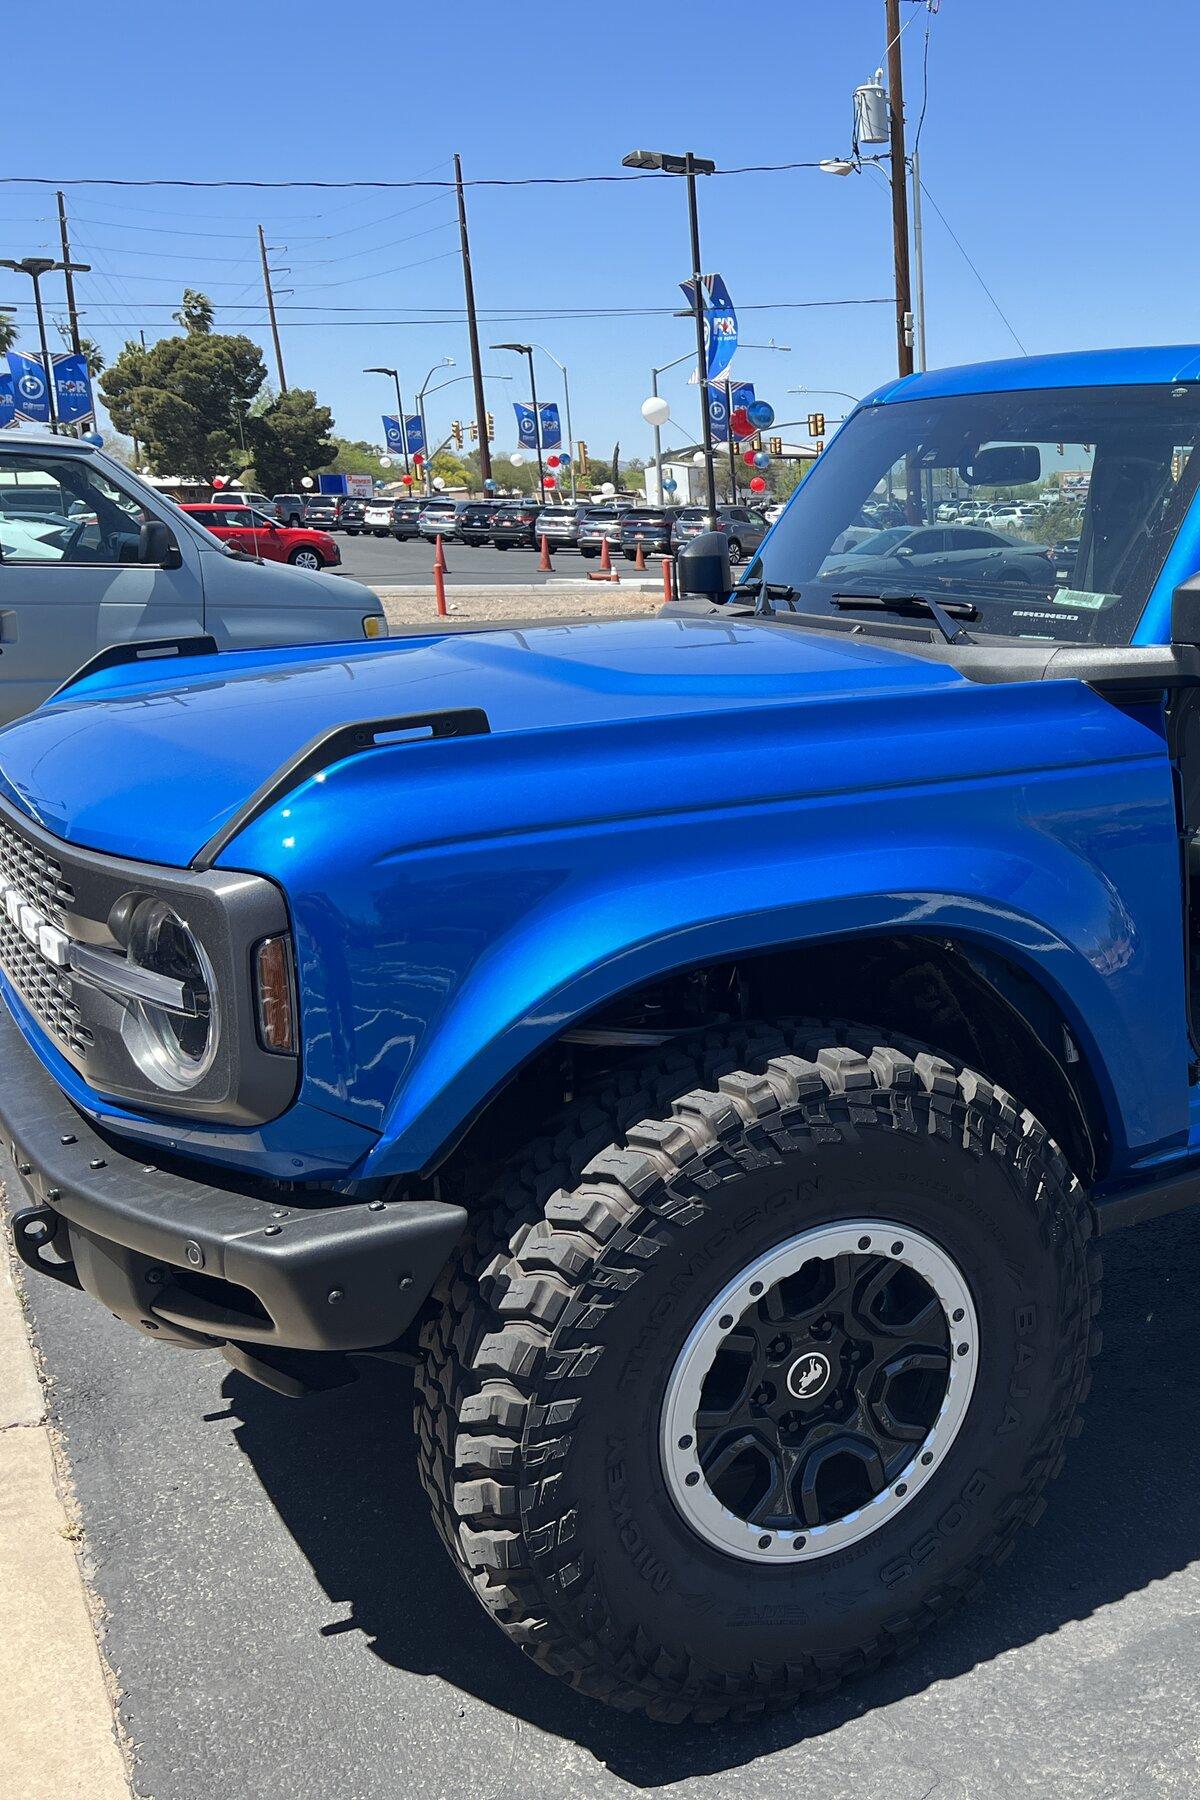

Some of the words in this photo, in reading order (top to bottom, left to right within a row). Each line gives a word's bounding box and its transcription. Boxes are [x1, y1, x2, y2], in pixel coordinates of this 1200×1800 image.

[713, 316, 737, 335] FOR
[57, 380, 86, 393] FOR
[0, 394, 14, 404] OR
[1012, 610, 1079, 621] BRONCO
[996, 1303, 1037, 1436] BAJA
[879, 1468, 996, 1590] BOSS
